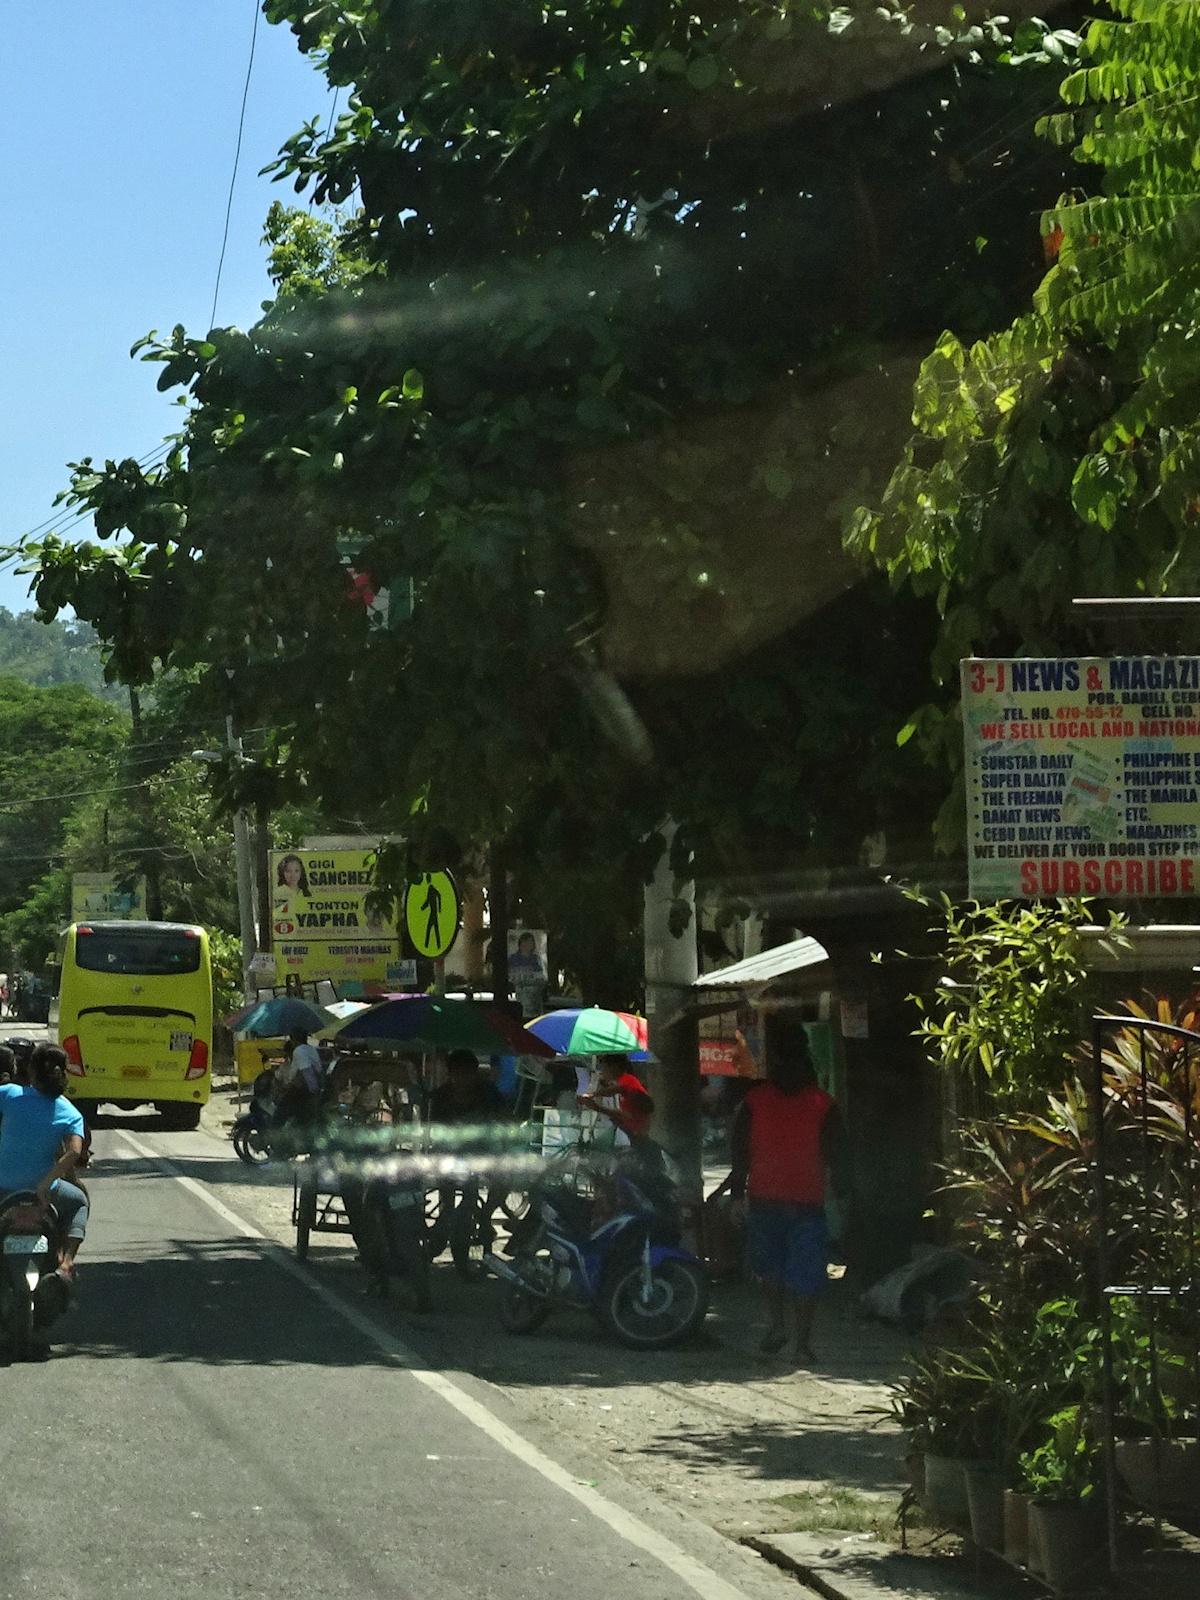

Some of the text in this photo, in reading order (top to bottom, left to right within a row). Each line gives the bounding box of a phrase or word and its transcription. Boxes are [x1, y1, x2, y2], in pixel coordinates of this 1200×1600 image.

[970, 660, 1199, 693] 3-J NEWS & MAGAZI
[1172, 691, 1200, 703] CEB
[1004, 707, 1028, 720] TEL.
[1031, 707, 1053, 720] NO.
[980, 720, 1200, 740] WE SELL LOCAL AND NATION
[981, 754, 1075, 770] SUNSTAR DAILY
[1123, 752, 1191, 768] PHILIPPINE
[981, 772, 1022, 788] SUPER
[1124, 770, 1191, 786] PHILIPPINE
[982, 790, 1063, 806] THE FREEMAN
[1125, 787, 1198, 804] THE MANILA
[1025, 808, 1061, 823] NEWS
[1125, 807, 1151, 822] ETC.
[983, 826, 1091, 842] CEBU DAILY NEWS
[1126, 824, 1197, 840] MAGAZINES
[974, 845, 995, 859] WE
[998, 844, 1050, 859] DELIVER
[1052, 844, 1069, 857] AT
[1071, 843, 1107, 857] YOUR
[1148, 842, 1180, 856] STEP
[309, 860, 335, 869] GIGI
[1021, 859, 1195, 895] SUBSCRIBE
[308, 901, 359, 911] TONTON
[296, 913, 359, 927] YAPHA
